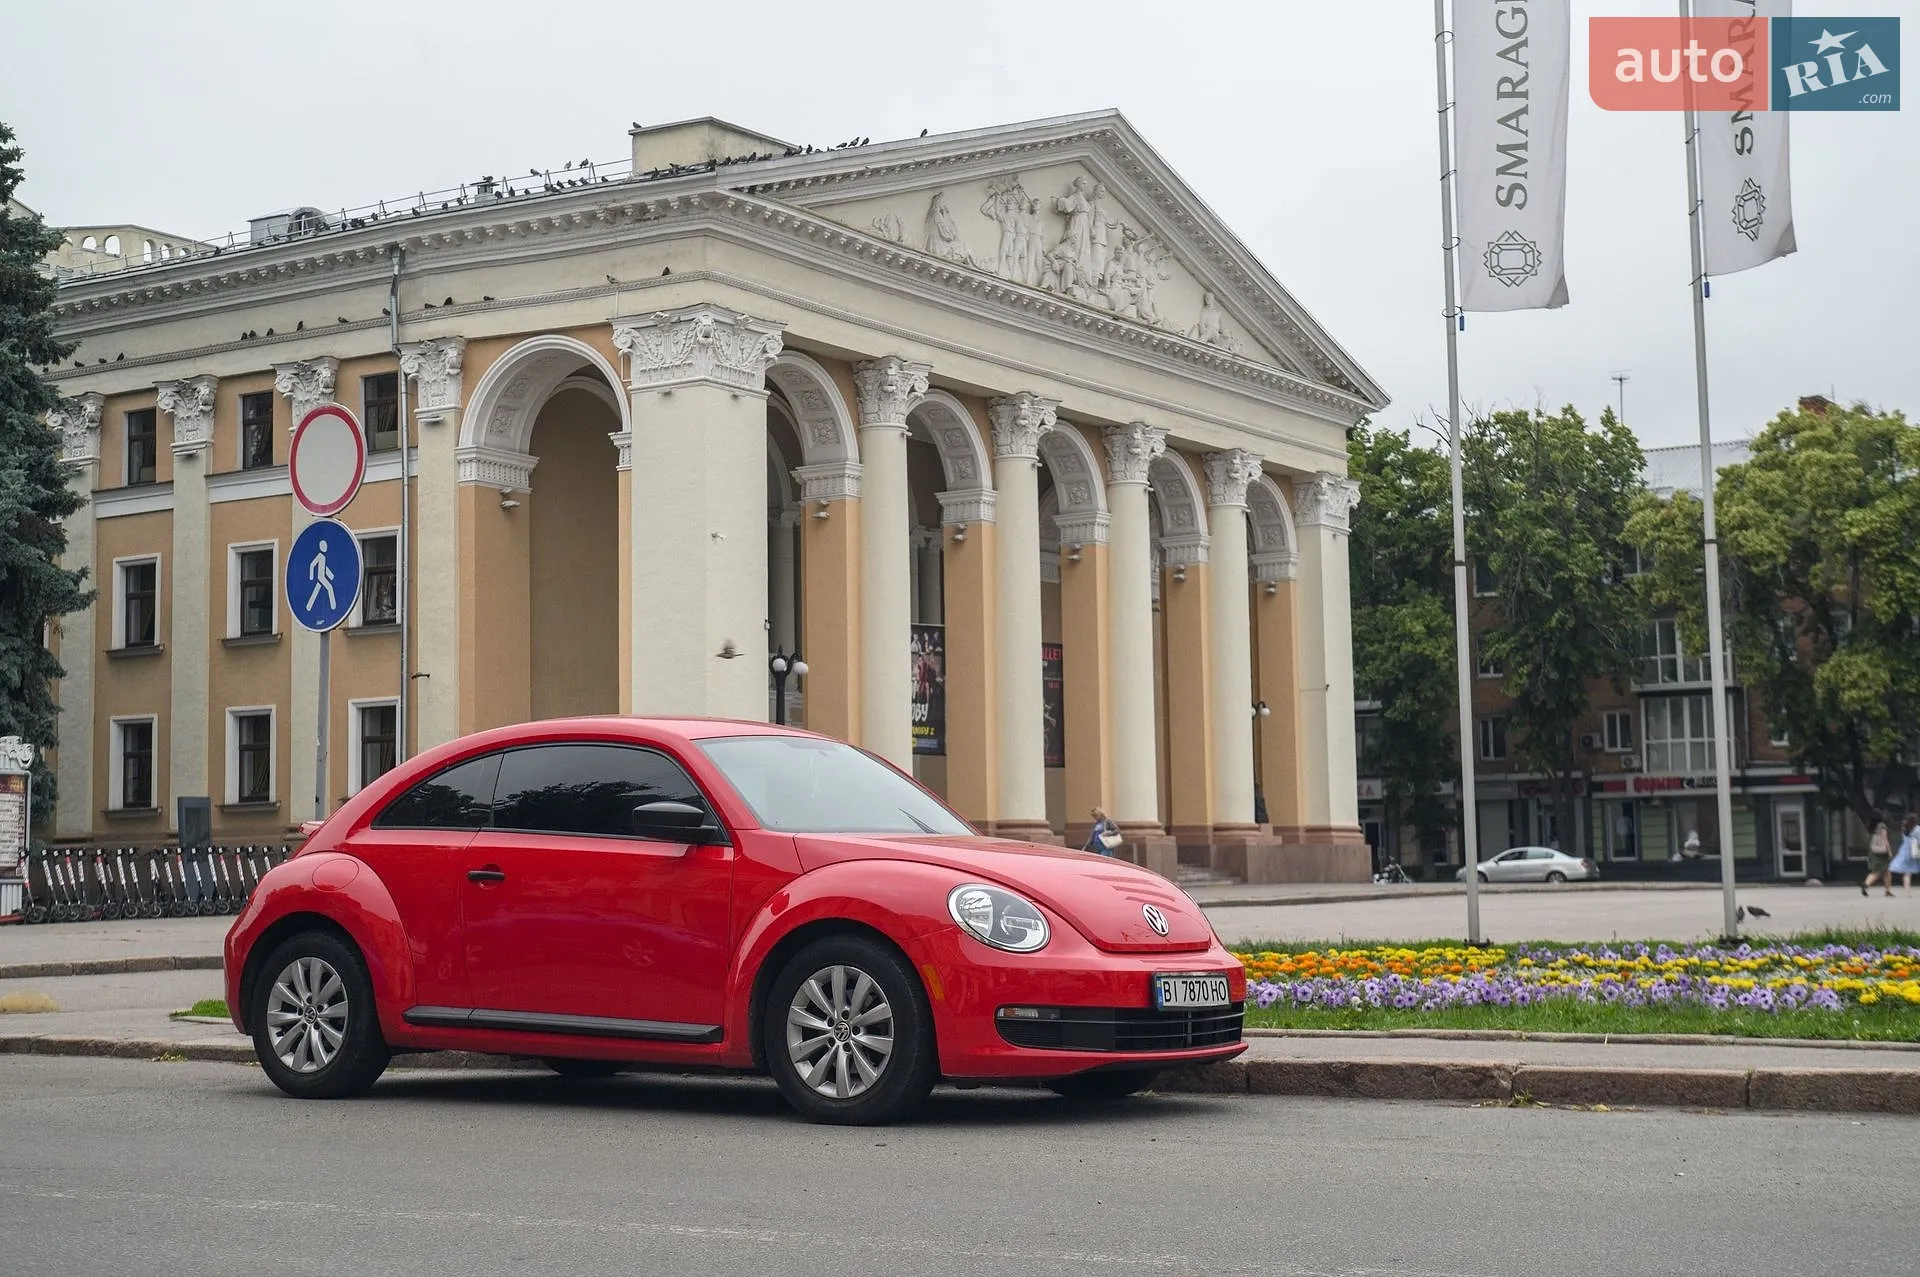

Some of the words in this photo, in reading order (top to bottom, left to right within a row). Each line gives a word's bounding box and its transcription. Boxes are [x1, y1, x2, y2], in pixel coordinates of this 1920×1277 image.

[1495, 0, 1529, 211] SMARAG
[1728, 0, 1757, 156] SMAR
[1163, 981, 1177, 1002] BI
[1182, 981, 1209, 1002] 7870
